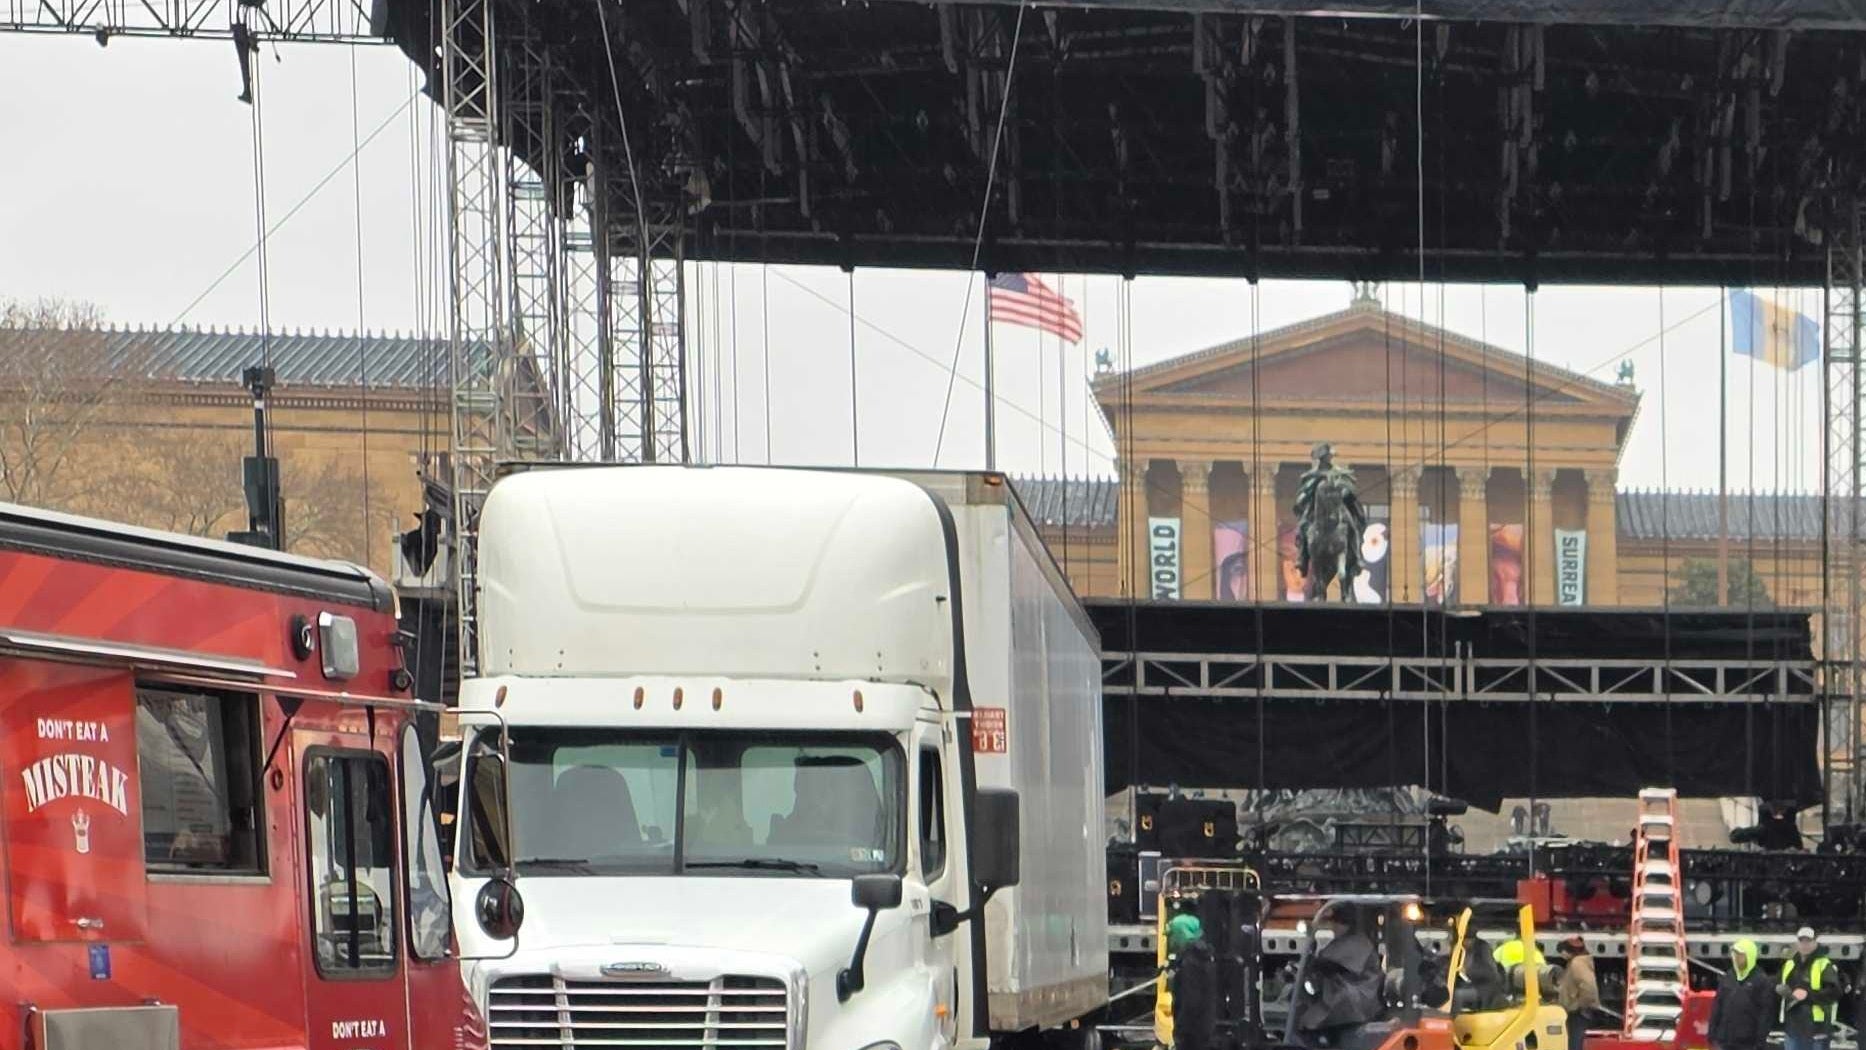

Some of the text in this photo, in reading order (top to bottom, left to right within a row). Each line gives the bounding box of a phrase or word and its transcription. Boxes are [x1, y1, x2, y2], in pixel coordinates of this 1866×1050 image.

[37, 718, 109, 742] DON'T EAT A
[22, 754, 128, 817] MISTEAK
[332, 1019, 386, 1039] DON'T EAT A
